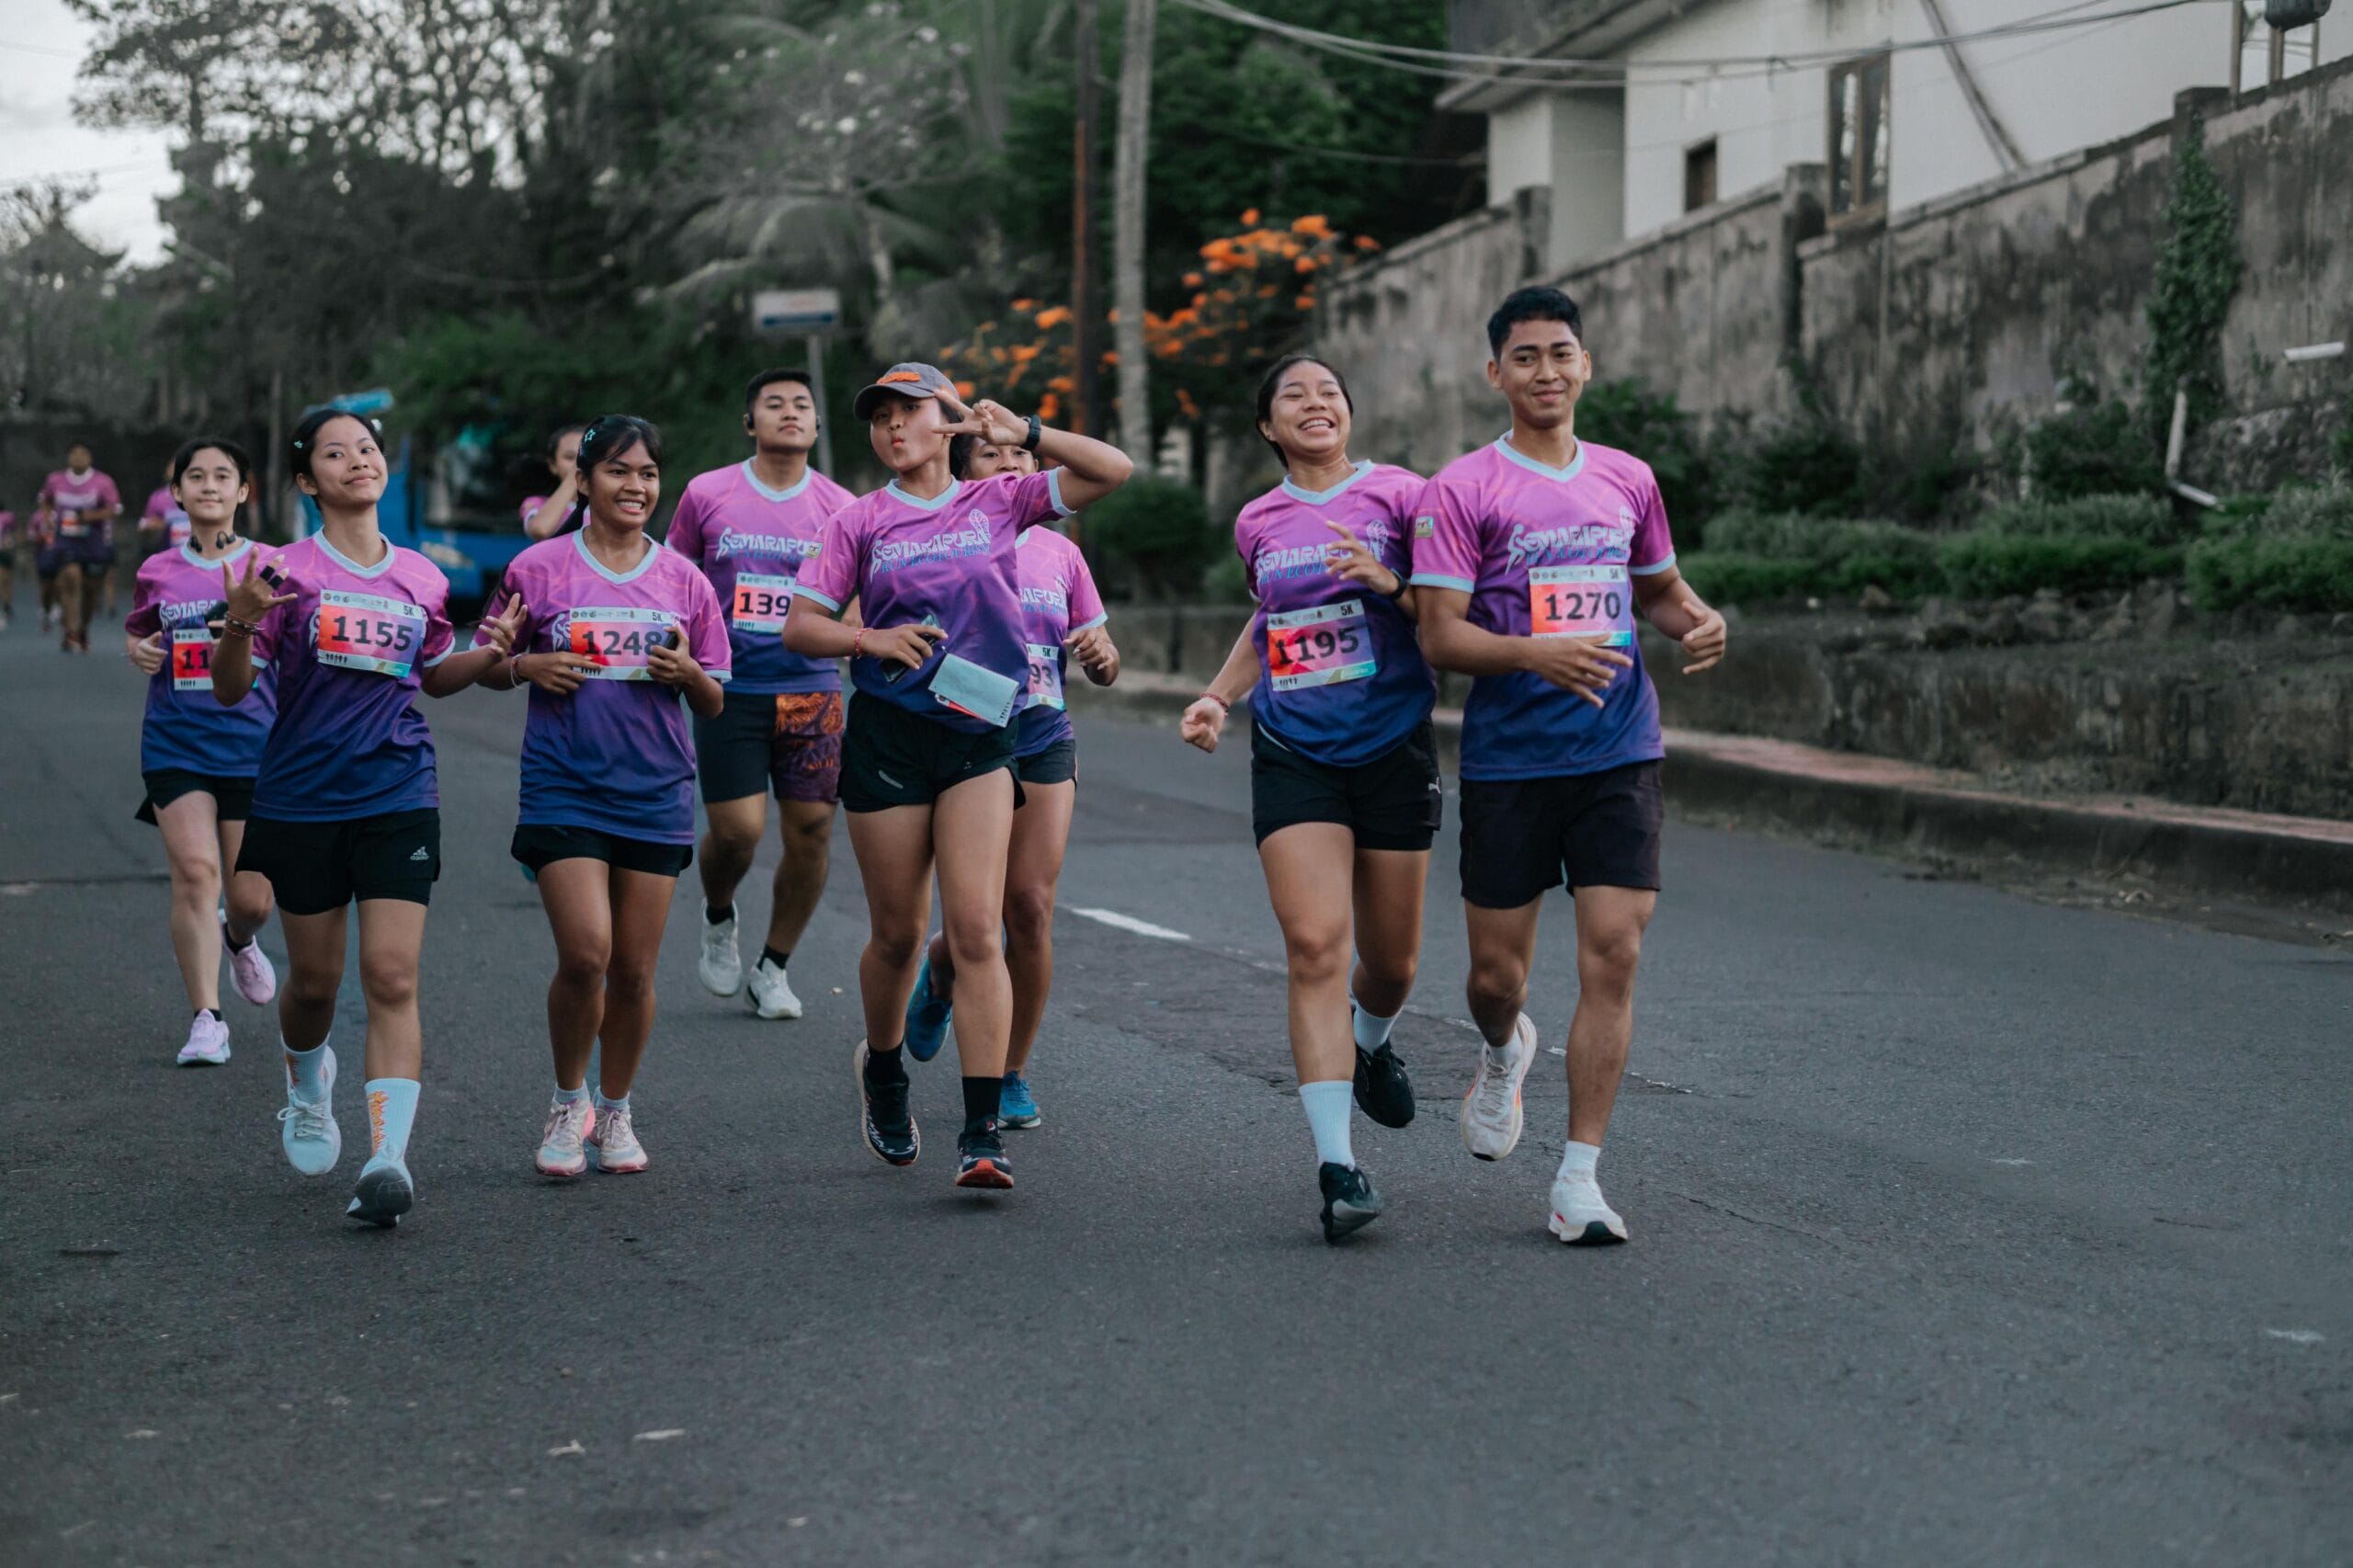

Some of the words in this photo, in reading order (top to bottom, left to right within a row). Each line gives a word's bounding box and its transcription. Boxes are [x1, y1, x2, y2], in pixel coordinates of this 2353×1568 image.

[716, 527, 809, 561] SEMARAPU
[404, 605, 415, 617] 5K
[652, 610, 664, 622] 5K
[738, 591, 791, 617] 139
[1340, 603, 1354, 617] 5K
[1545, 591, 1621, 621] 1270
[331, 615, 414, 652] 1155
[582, 630, 663, 656] 1248
[1275, 626, 1359, 665] 1195
[181, 649, 210, 670] 11
[1041, 646, 1051, 658] 5K
[1029, 663, 1055, 688] 93
